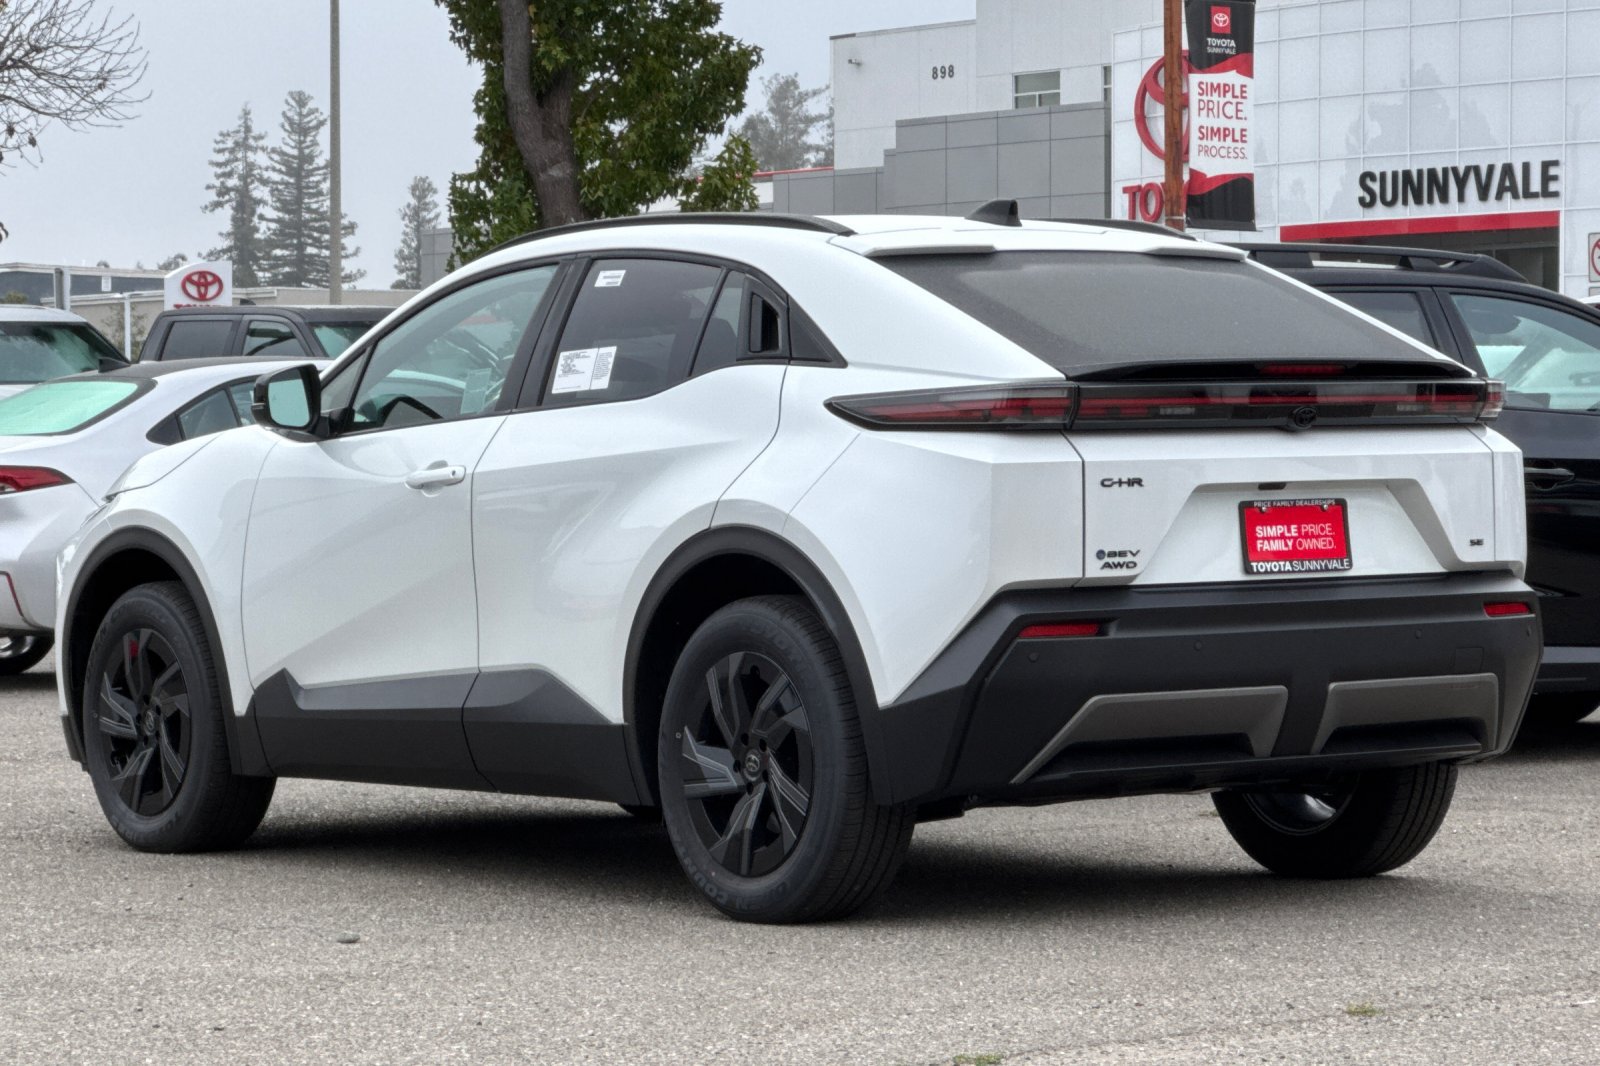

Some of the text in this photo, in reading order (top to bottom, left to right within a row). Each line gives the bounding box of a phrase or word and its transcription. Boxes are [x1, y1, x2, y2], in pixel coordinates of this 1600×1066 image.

[1206, 37, 1236, 47] TOYOTA
[931, 64, 955, 80] 898
[1197, 81, 1248, 99] SIMPLE
[1197, 98, 1248, 121] PRICE.
[1197, 125, 1248, 143] SIMPLE
[1197, 144, 1248, 160] PROCESS.
[1358, 159, 1561, 209] SUNNYVALE
[1254, 500, 1272, 508] PRICE
[1273, 499, 1295, 507] FAMILY
[1255, 523, 1335, 537] SIMPLE PRICE.
[1256, 537, 1336, 551] FAMILY OWNED.
[1100, 561, 1137, 570] AWD
